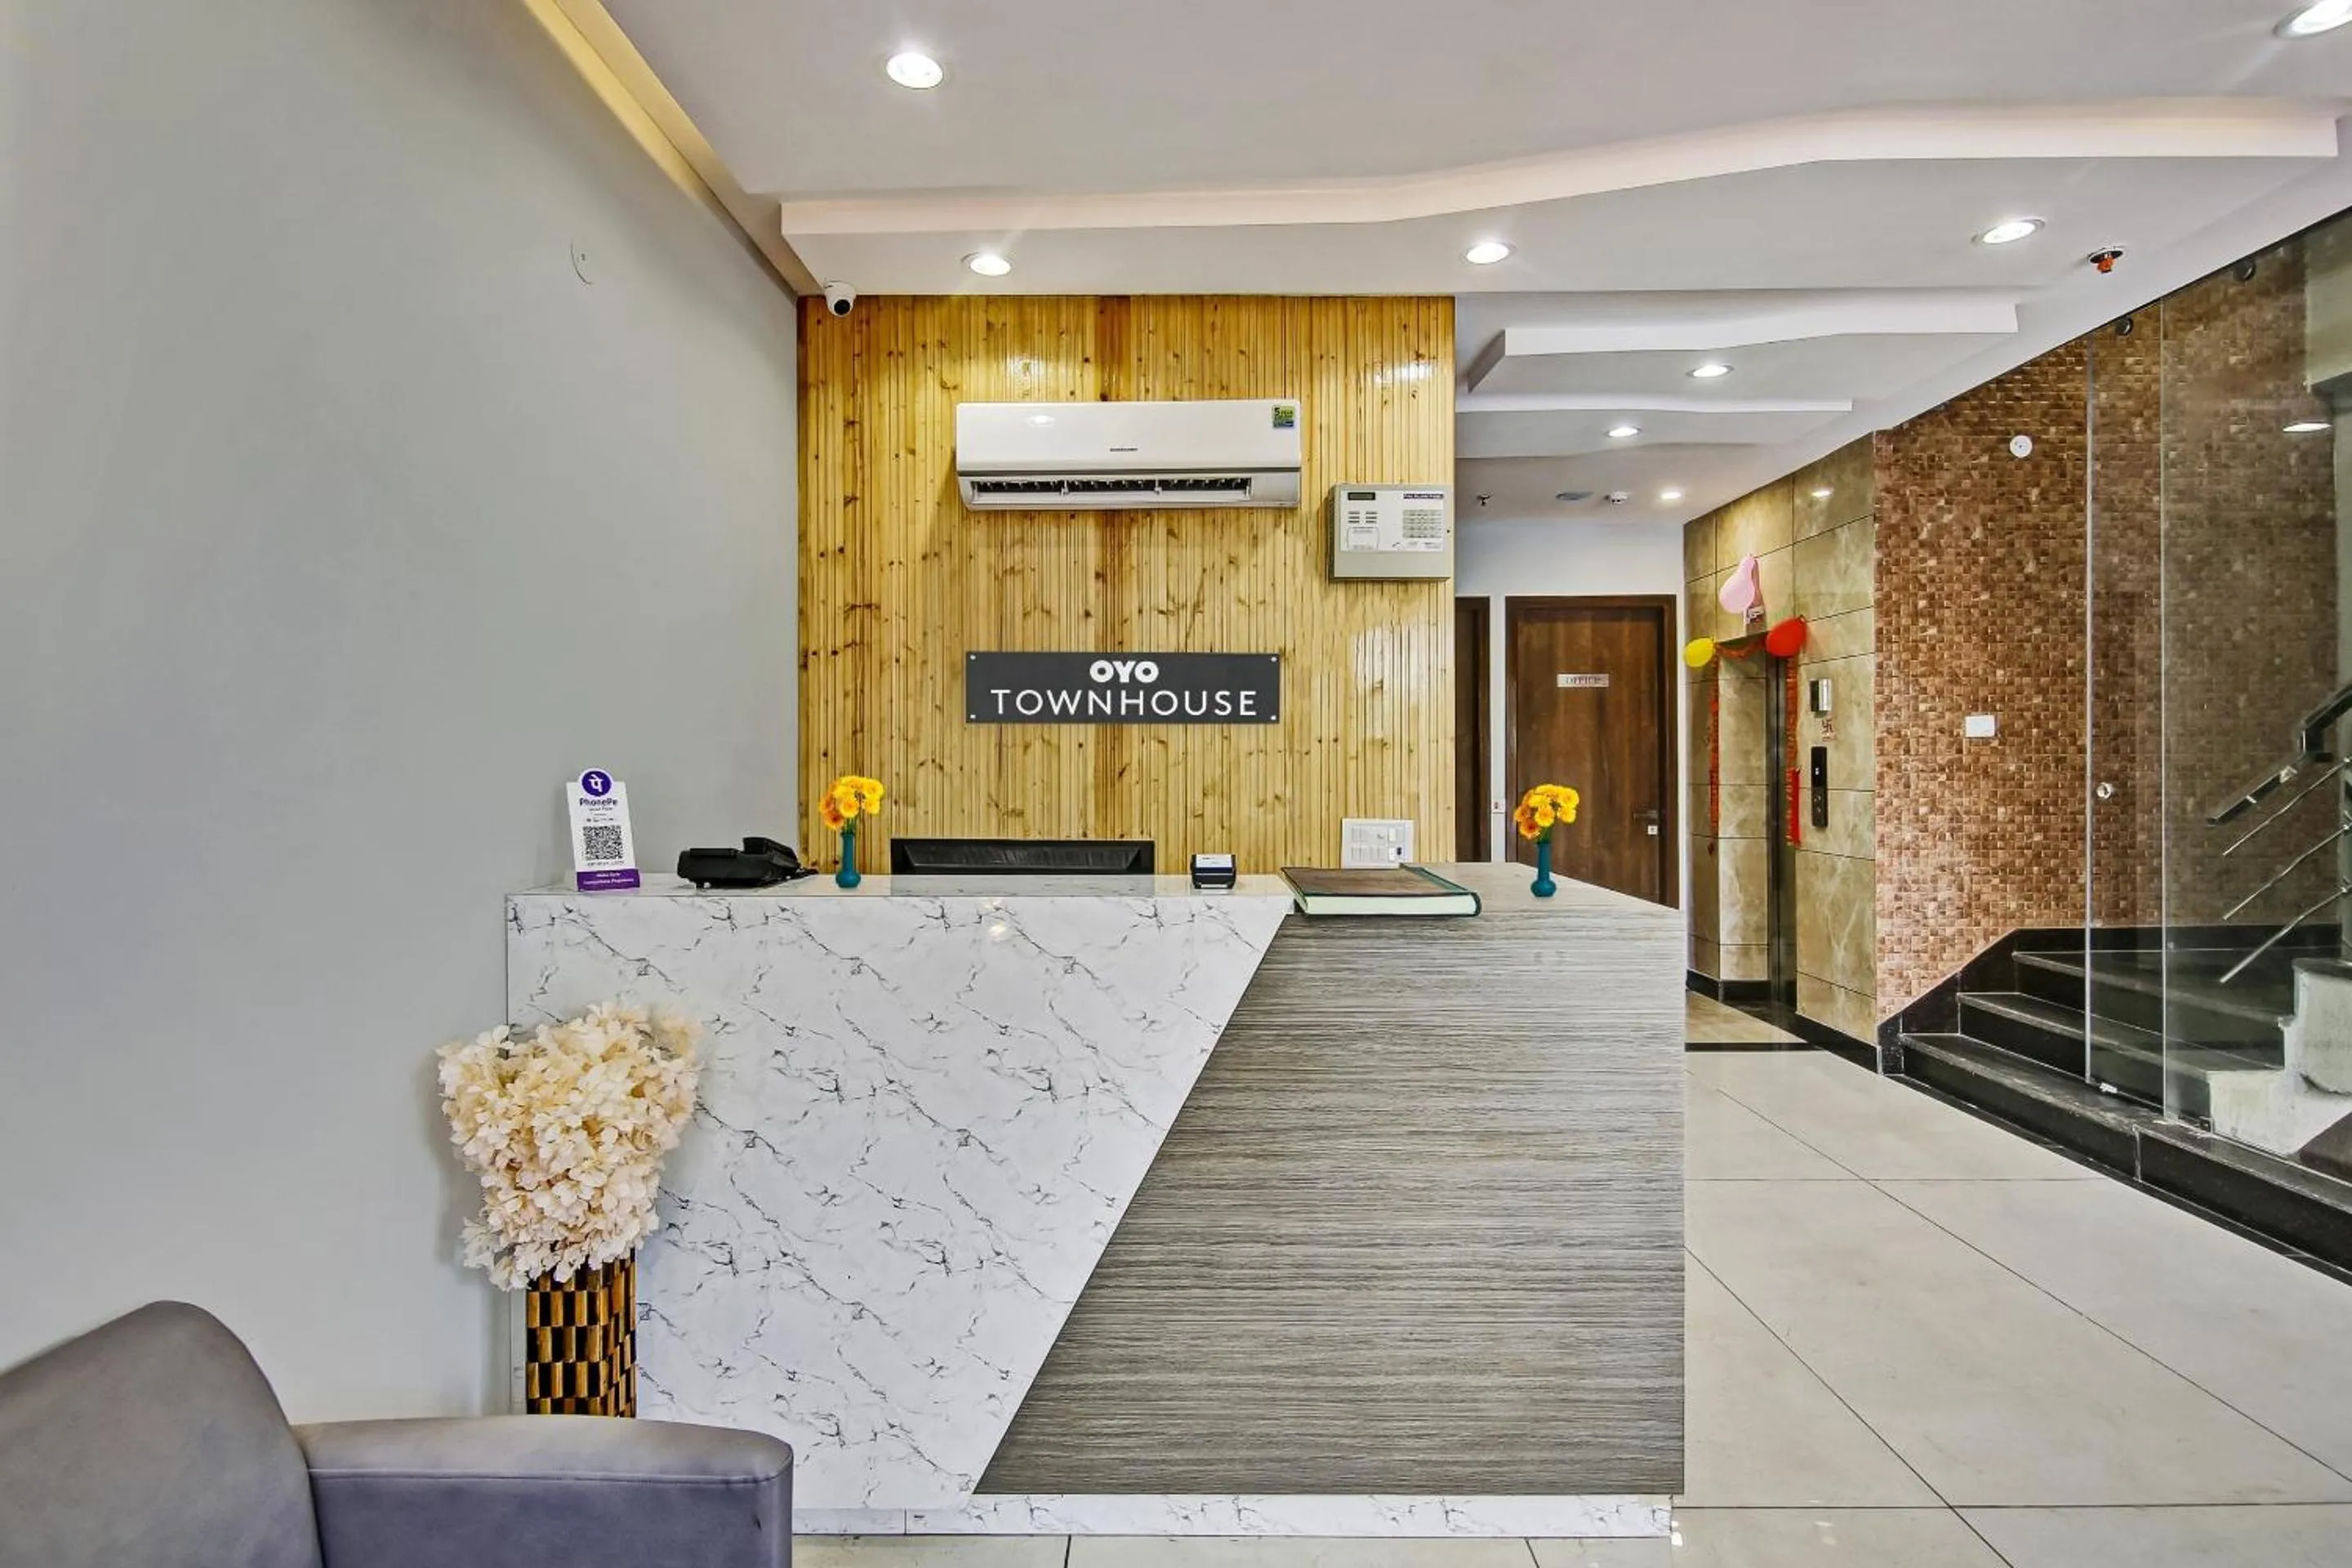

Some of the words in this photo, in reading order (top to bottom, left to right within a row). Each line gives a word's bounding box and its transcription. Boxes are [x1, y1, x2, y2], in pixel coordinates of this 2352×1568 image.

[1089, 660, 1159, 683] OYO
[991, 689, 1256, 715] TOWNHOUSE
[580, 797, 618, 806] PhonePe
